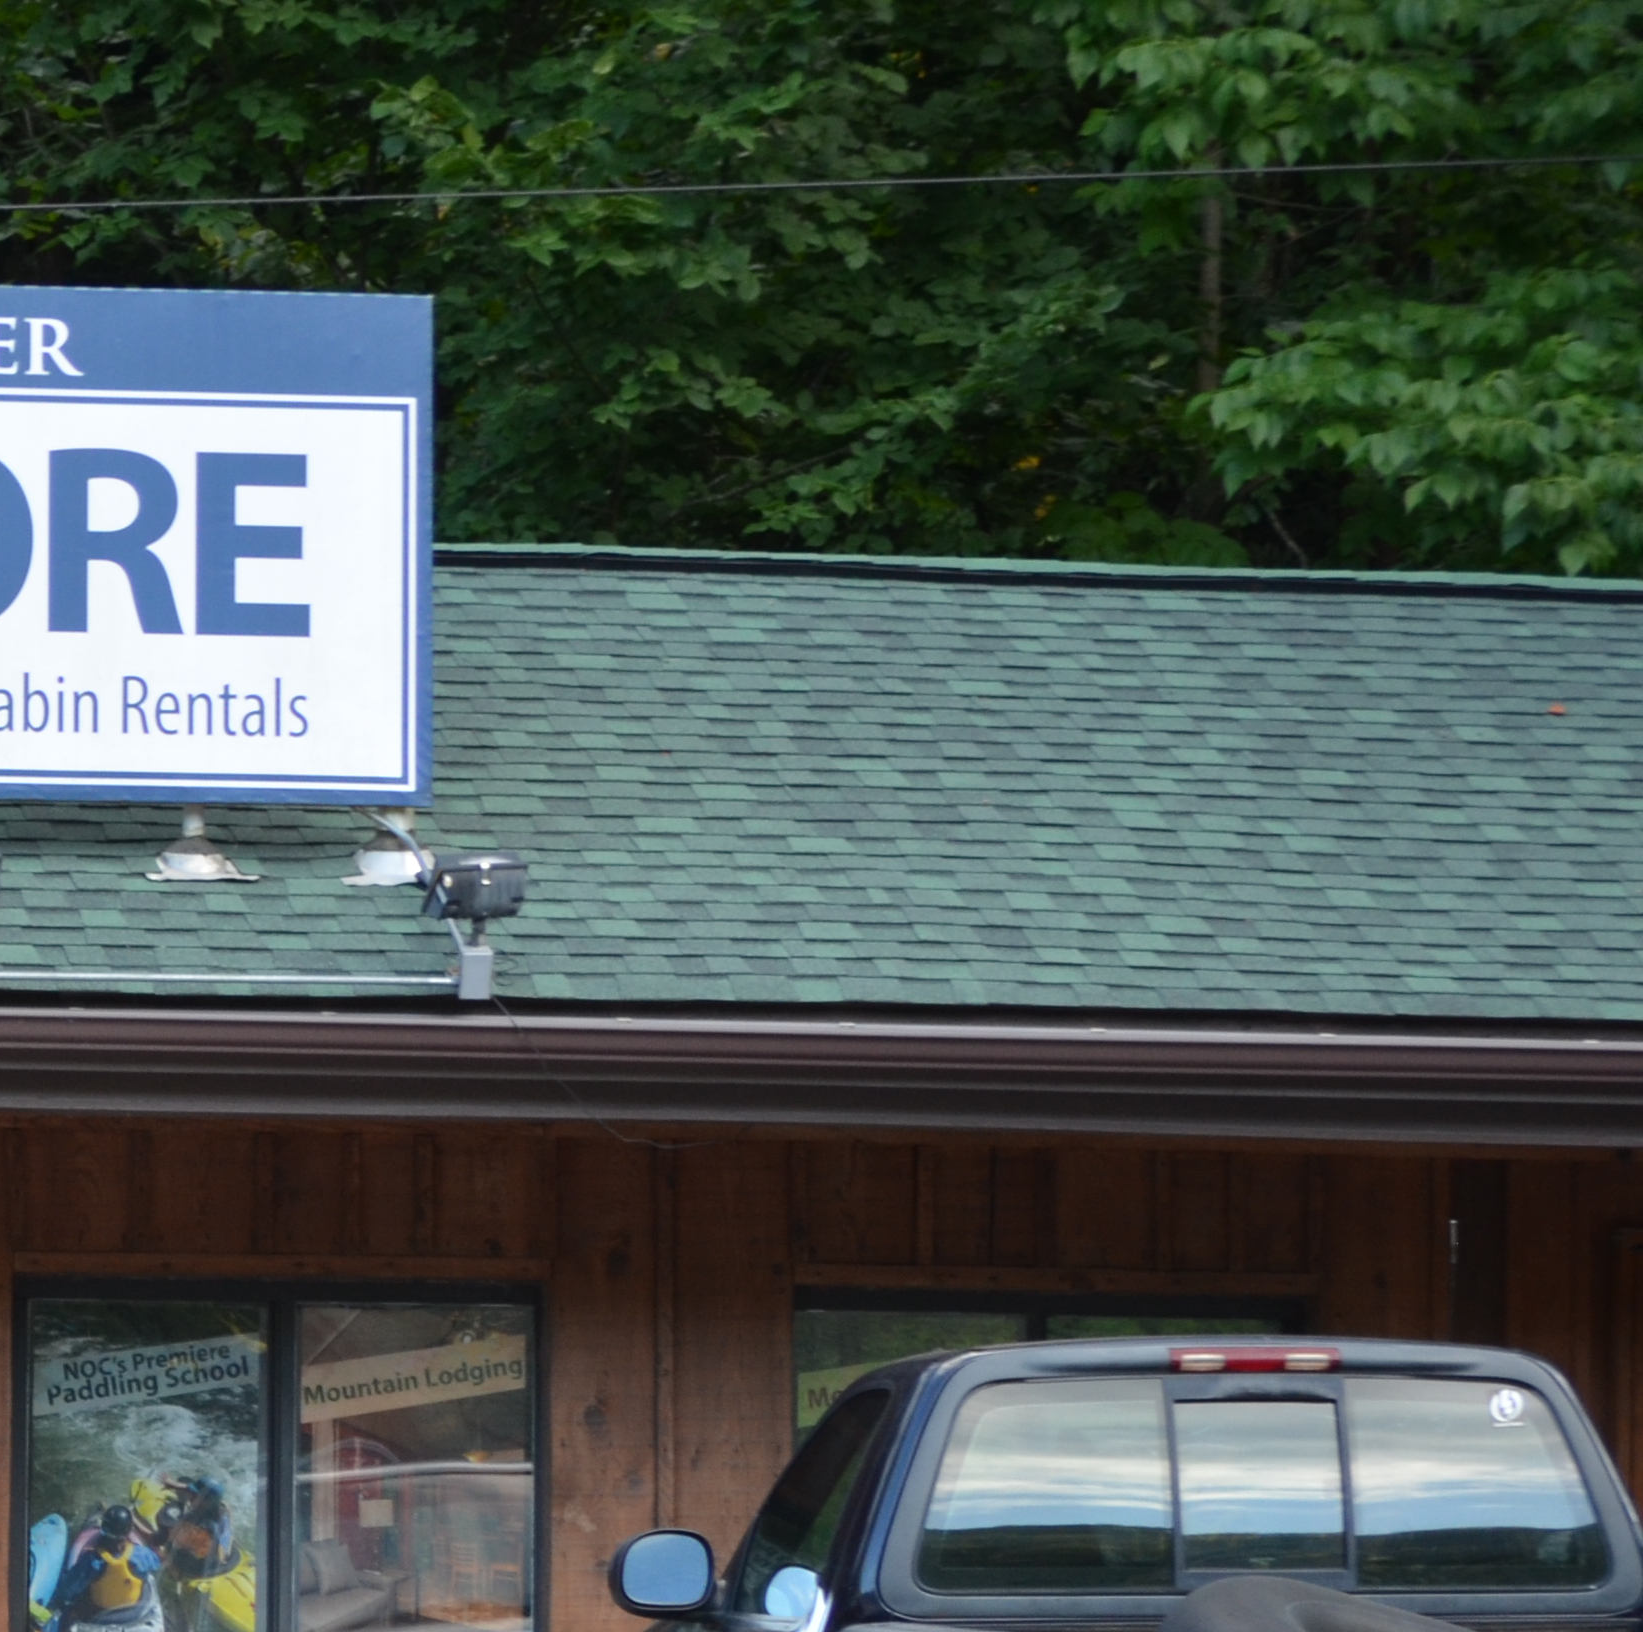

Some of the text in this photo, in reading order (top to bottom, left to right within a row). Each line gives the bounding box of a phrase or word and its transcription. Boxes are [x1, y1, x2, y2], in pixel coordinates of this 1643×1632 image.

[121, 675, 309, 738] Rentals
[46, 1355, 250, 1406] Paddling School
[62, 1345, 231, 1382] NOC's Premiere
[302, 1358, 524, 1406] Mountain Lodging
